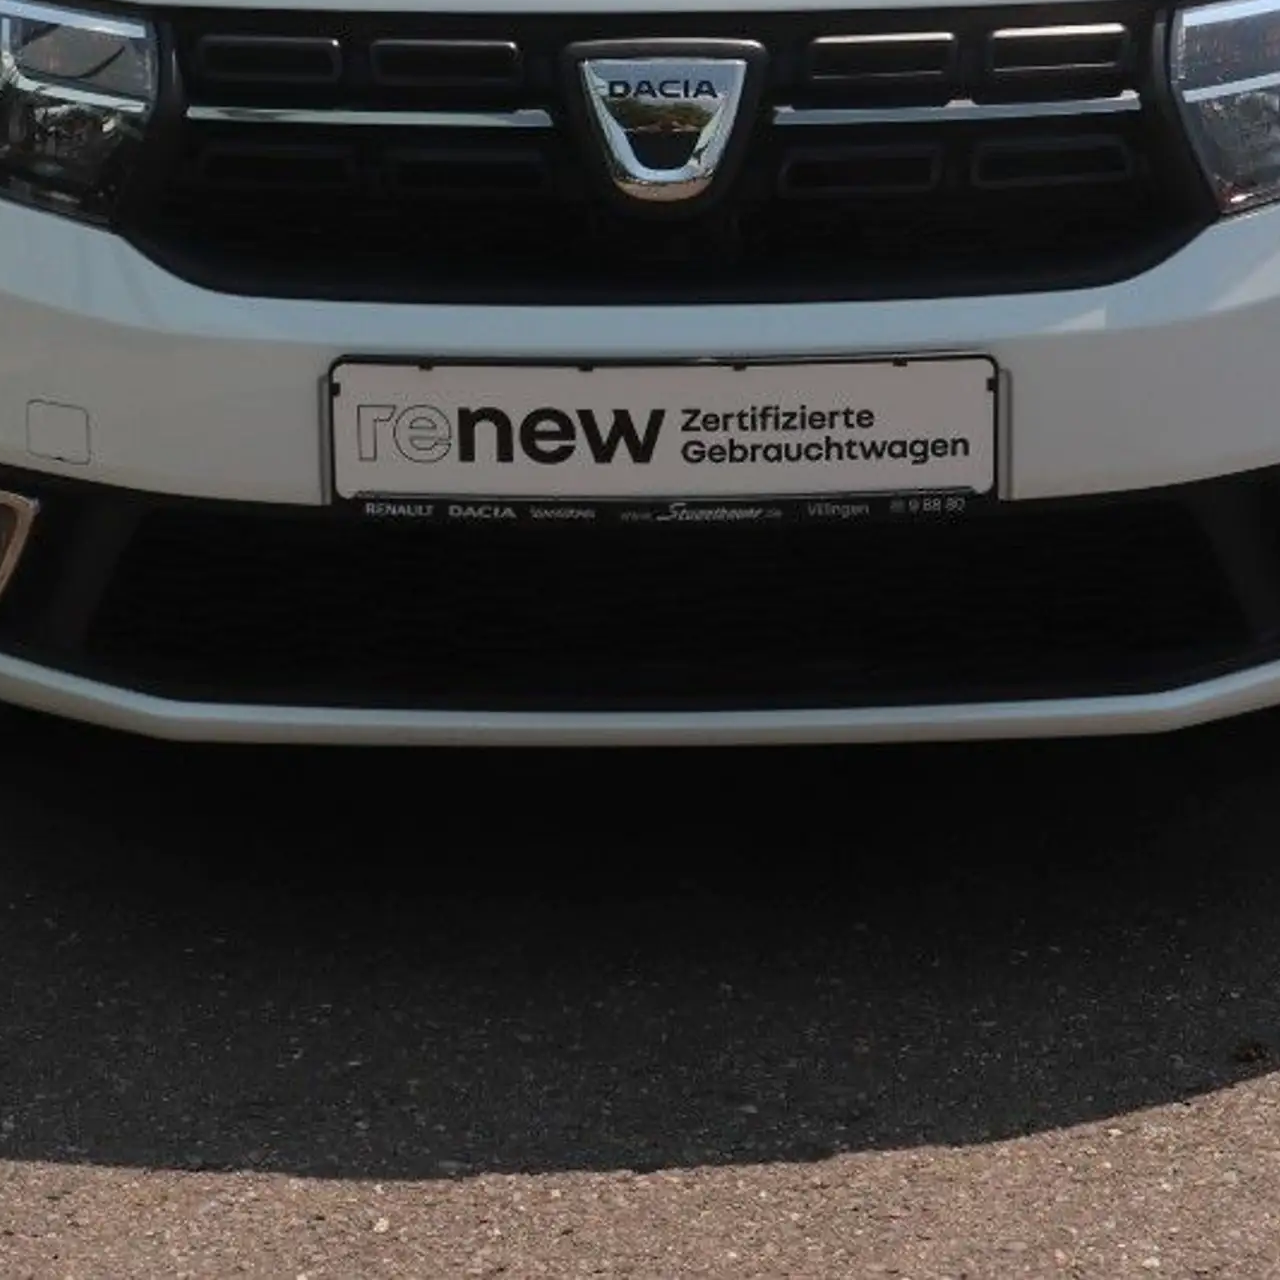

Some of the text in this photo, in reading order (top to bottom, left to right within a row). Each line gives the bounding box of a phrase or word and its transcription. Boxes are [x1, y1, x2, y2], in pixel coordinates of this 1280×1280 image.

[608, 80, 718, 99] DACIA
[680, 405, 875, 433] Zertifizierte
[356, 404, 666, 464] renew
[680, 435, 971, 465] Gebrauchtwagen
[365, 503, 435, 517] RENAULT
[448, 504, 517, 519] DACIA
